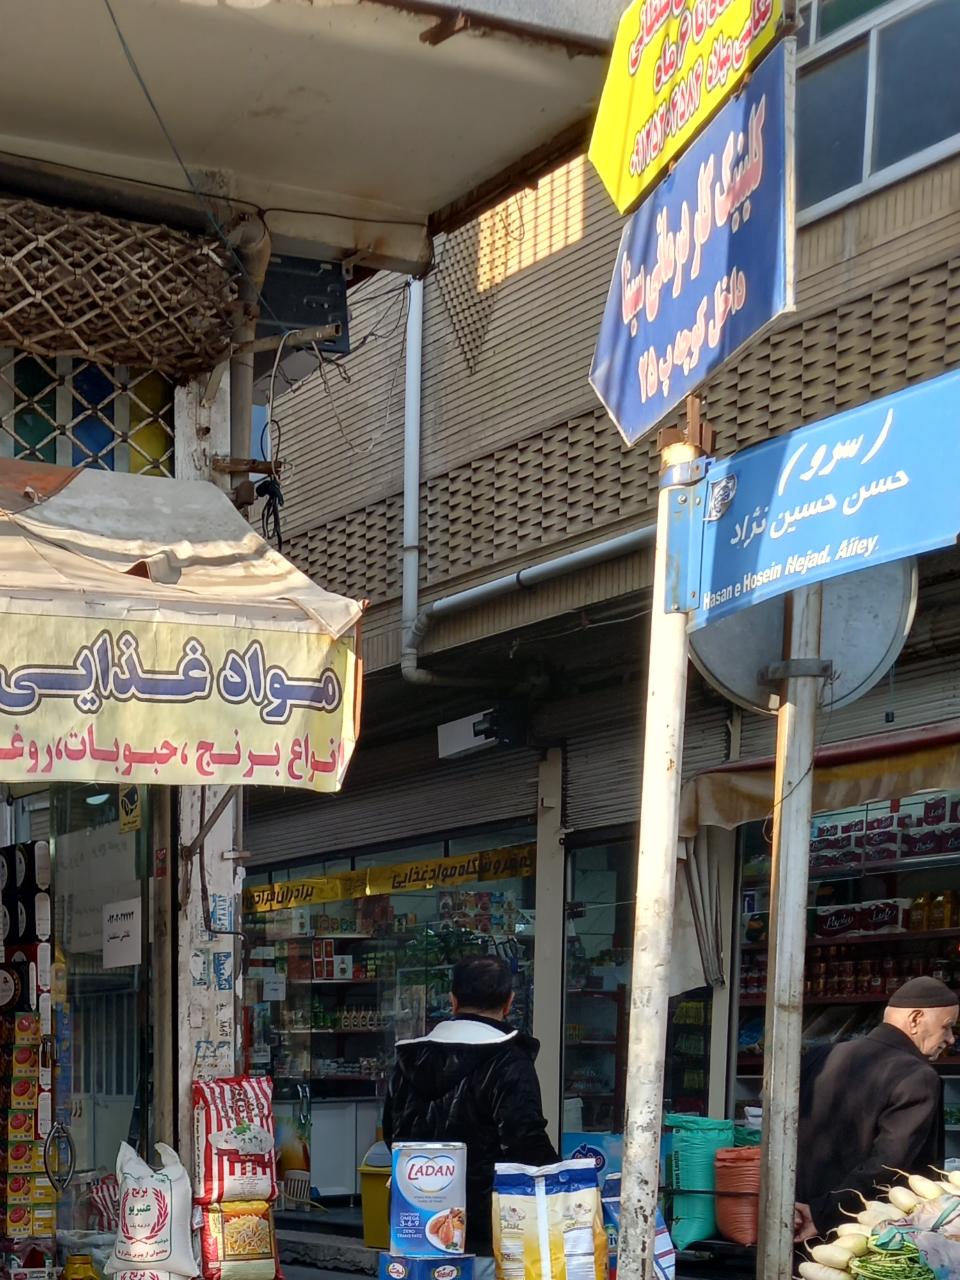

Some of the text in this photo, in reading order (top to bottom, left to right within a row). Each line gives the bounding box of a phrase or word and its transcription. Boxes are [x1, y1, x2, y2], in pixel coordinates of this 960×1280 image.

[715, 93, 766, 234] کلینیک
[646, 201, 690, 322] درمانی
[673, 296, 709, 376] کوچه
[708, 266, 747, 349] داخل
[730, 470, 910, 549] حسن حسین نژاد
[703, 587, 733, 611] Hasan
[743, 562, 782, 593] Hosein
[217, 640, 343, 724] مواد
[195, 729, 281, 778] برنج
[128, 1203, 151, 1216] عنبربو
[131, 1186, 148, 1198] برنج
[407, 1163, 455, 1181] LADAN
